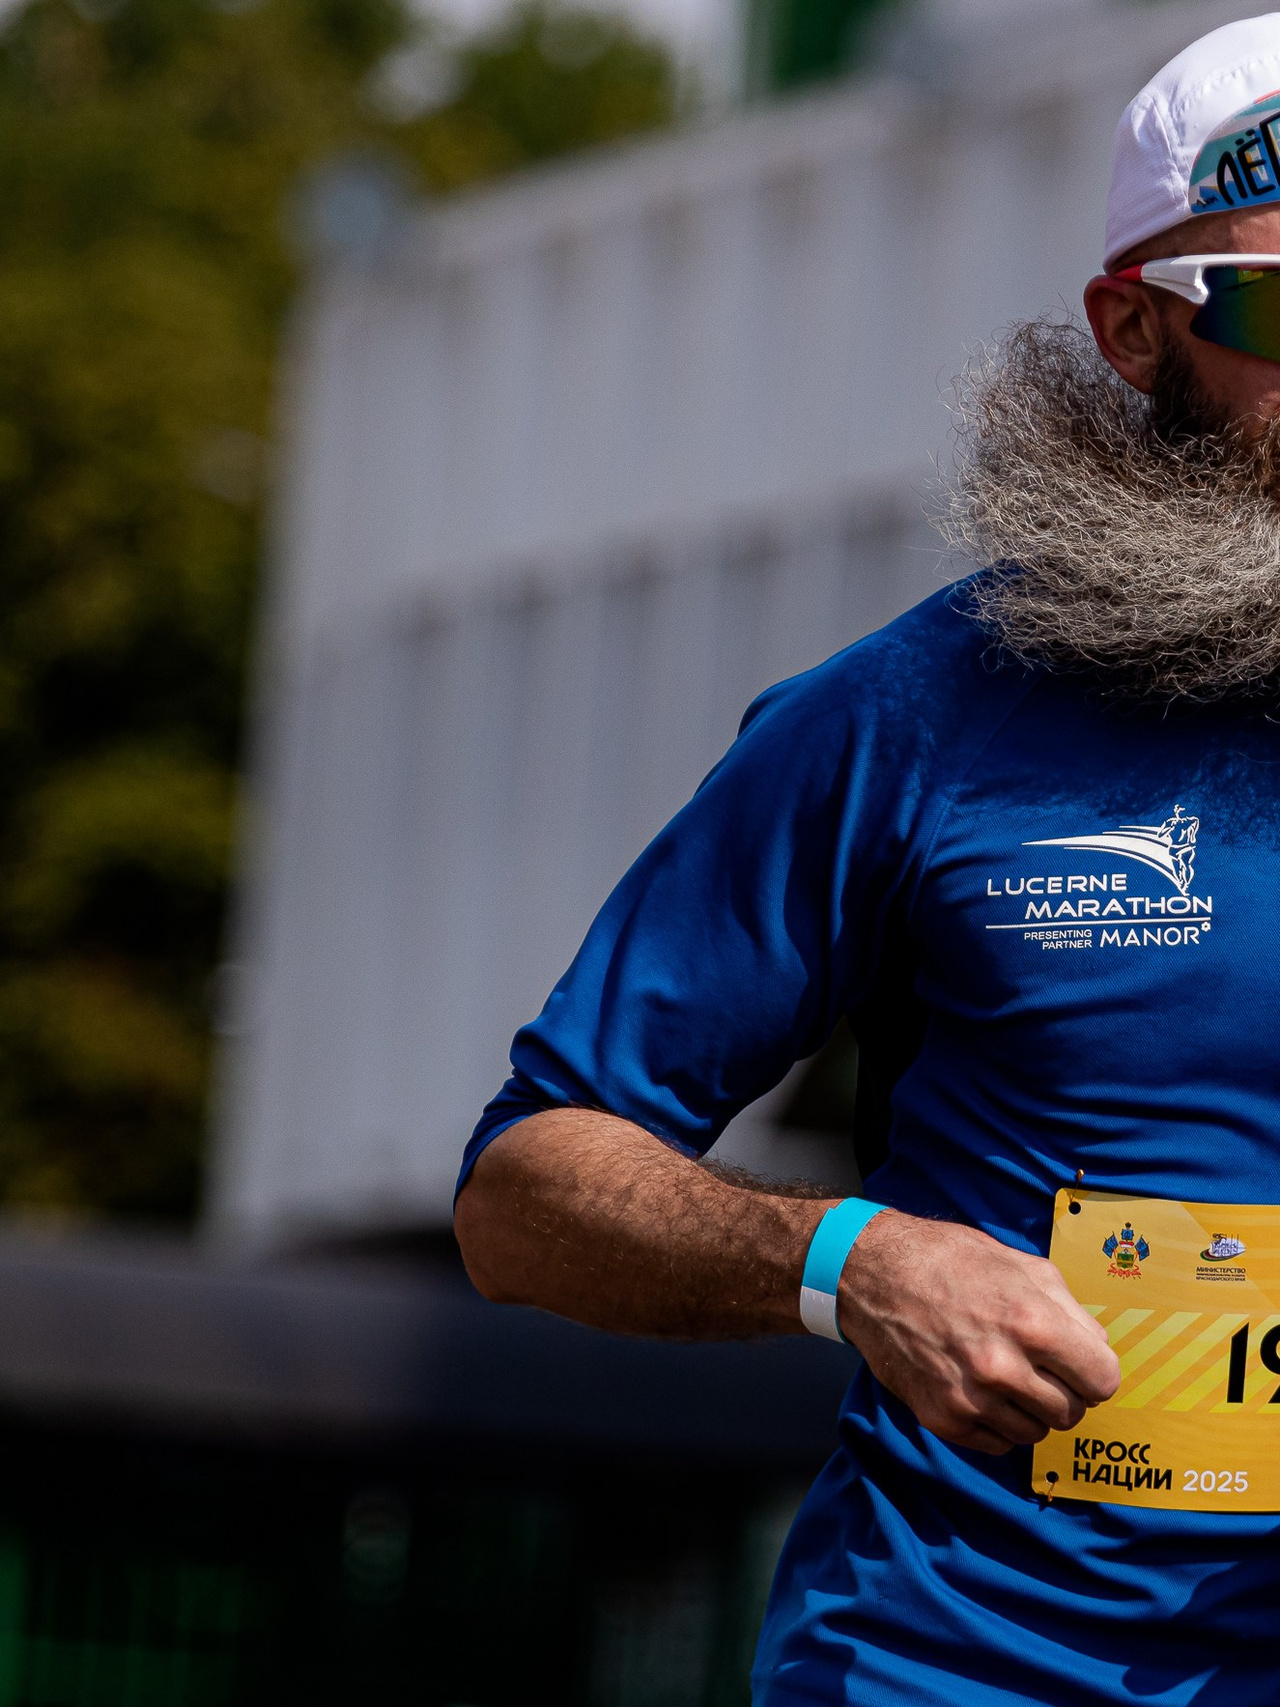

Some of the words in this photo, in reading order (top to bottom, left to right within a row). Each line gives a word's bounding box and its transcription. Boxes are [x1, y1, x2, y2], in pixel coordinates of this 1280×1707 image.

[987, 873, 1128, 896] LUCERNE
[1025, 896, 1212, 919] MARATHON
[1024, 929, 1092, 940] PRESENTING
[1042, 939, 1092, 950] PARTNER
[1100, 926, 1200, 947] MANOR
[1196, 1266, 1246, 1274] МИНИСТЕРСТВО
[1074, 1437, 1151, 1465] КРОСС
[1072, 1460, 1173, 1492] НАЦИИ
[1182, 1469, 1249, 1493] 2025
